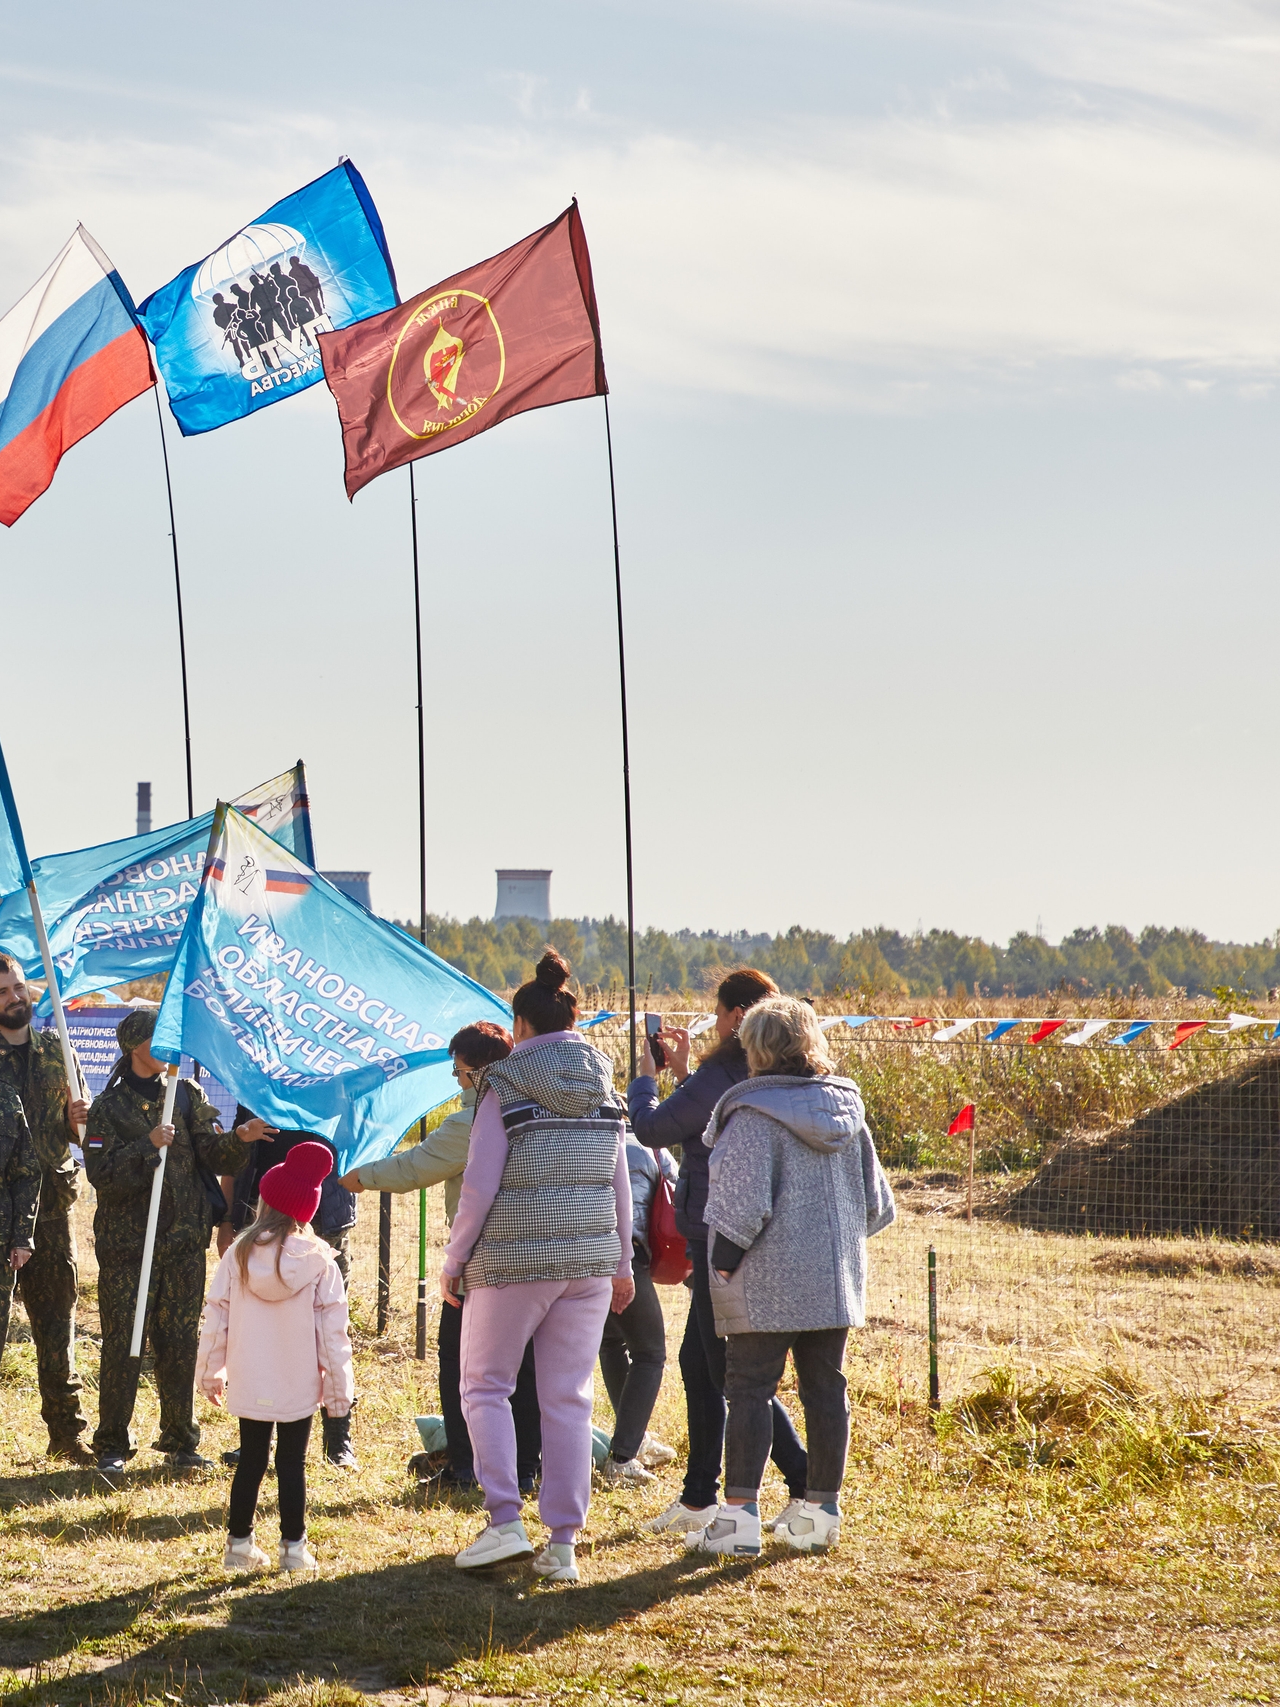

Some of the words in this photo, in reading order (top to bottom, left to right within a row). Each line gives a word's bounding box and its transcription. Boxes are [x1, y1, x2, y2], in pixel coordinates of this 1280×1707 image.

[202, 966, 361, 1078] КЛИНИЧЕС
[218, 945, 400, 1070] ОБЛАСТНАЯ
[236, 914, 447, 1052] ИВАНОВСКАЯ
[78, 1052, 115, 1062] ИКЛАДНЫМ
